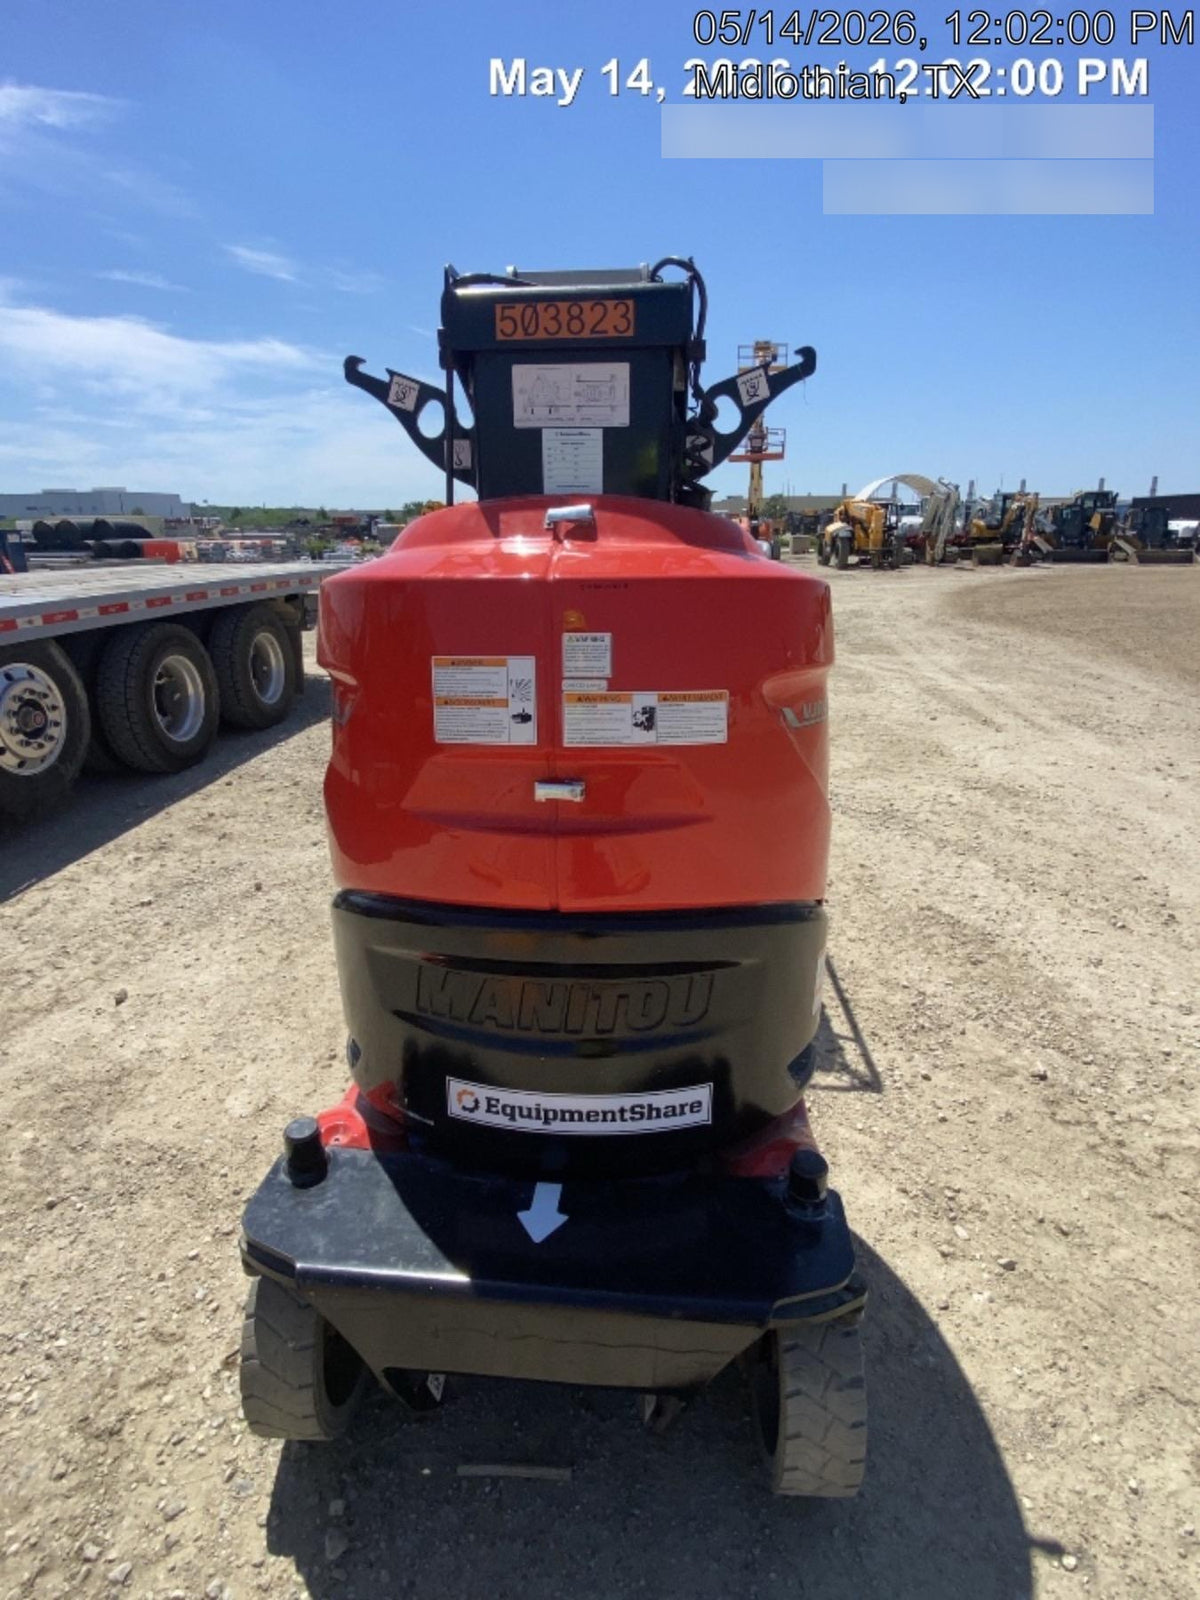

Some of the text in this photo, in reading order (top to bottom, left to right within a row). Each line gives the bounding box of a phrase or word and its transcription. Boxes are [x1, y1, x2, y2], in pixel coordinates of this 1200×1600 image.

[499, 301, 632, 338] 503823
[414, 965, 715, 1035] MANITOU
[484, 1095, 703, 1125] EquipmentShare
